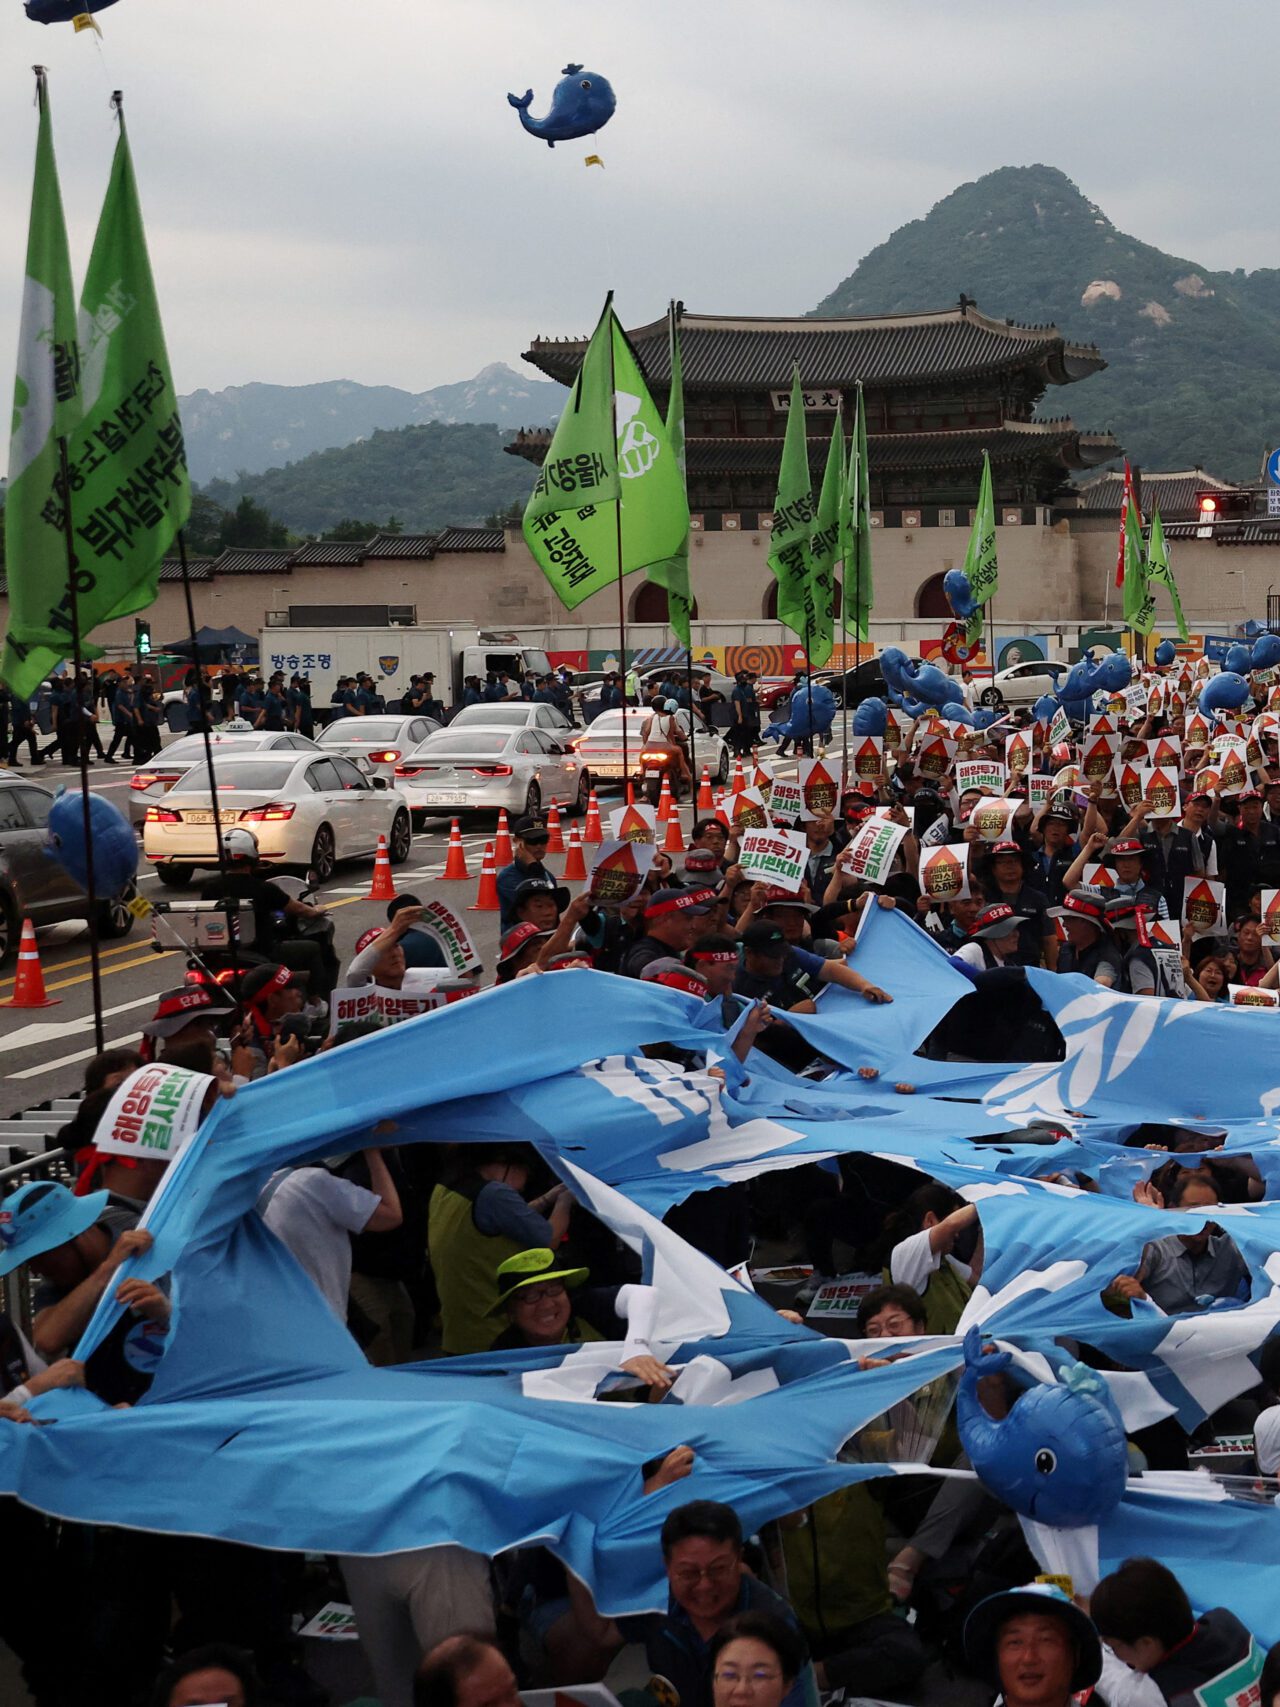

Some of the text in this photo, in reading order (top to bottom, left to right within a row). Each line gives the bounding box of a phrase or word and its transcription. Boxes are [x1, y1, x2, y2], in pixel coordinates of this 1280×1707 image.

[543, 527, 597, 588] 고양지대
[271, 654, 331, 669] 방송조명
[959, 765, 1000, 777] 해양투기
[743, 837, 801, 864] 해양투기
[850, 826, 881, 876] 해양투기
[865, 825, 897, 879] 결사반대!
[740, 853, 802, 880] 결사반대!
